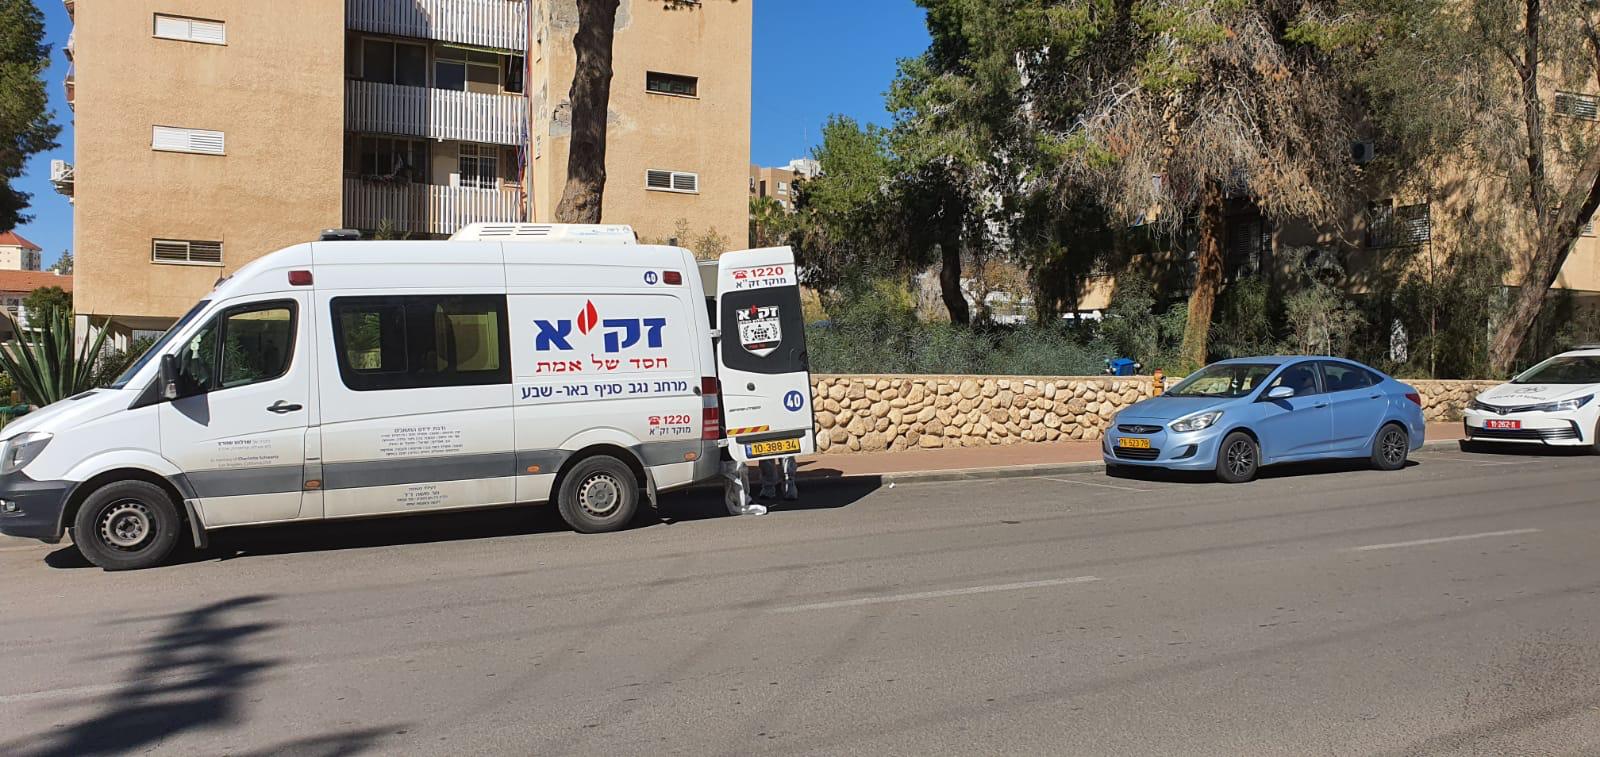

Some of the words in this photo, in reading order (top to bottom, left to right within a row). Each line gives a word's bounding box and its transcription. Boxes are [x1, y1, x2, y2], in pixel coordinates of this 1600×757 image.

[751, 266, 784, 278] 1220
[762, 277, 787, 287] מוקד
[535, 359, 583, 373] אמת
[591, 353, 620, 371] של
[629, 357, 668, 369] חסד
[594, 383, 623, 398] סניף
[627, 382, 649, 394] נגב
[653, 380, 688, 393] מרחב
[786, 394, 801, 408] 40
[663, 414, 691, 425] 1220
[671, 426, 692, 436] מוקד
